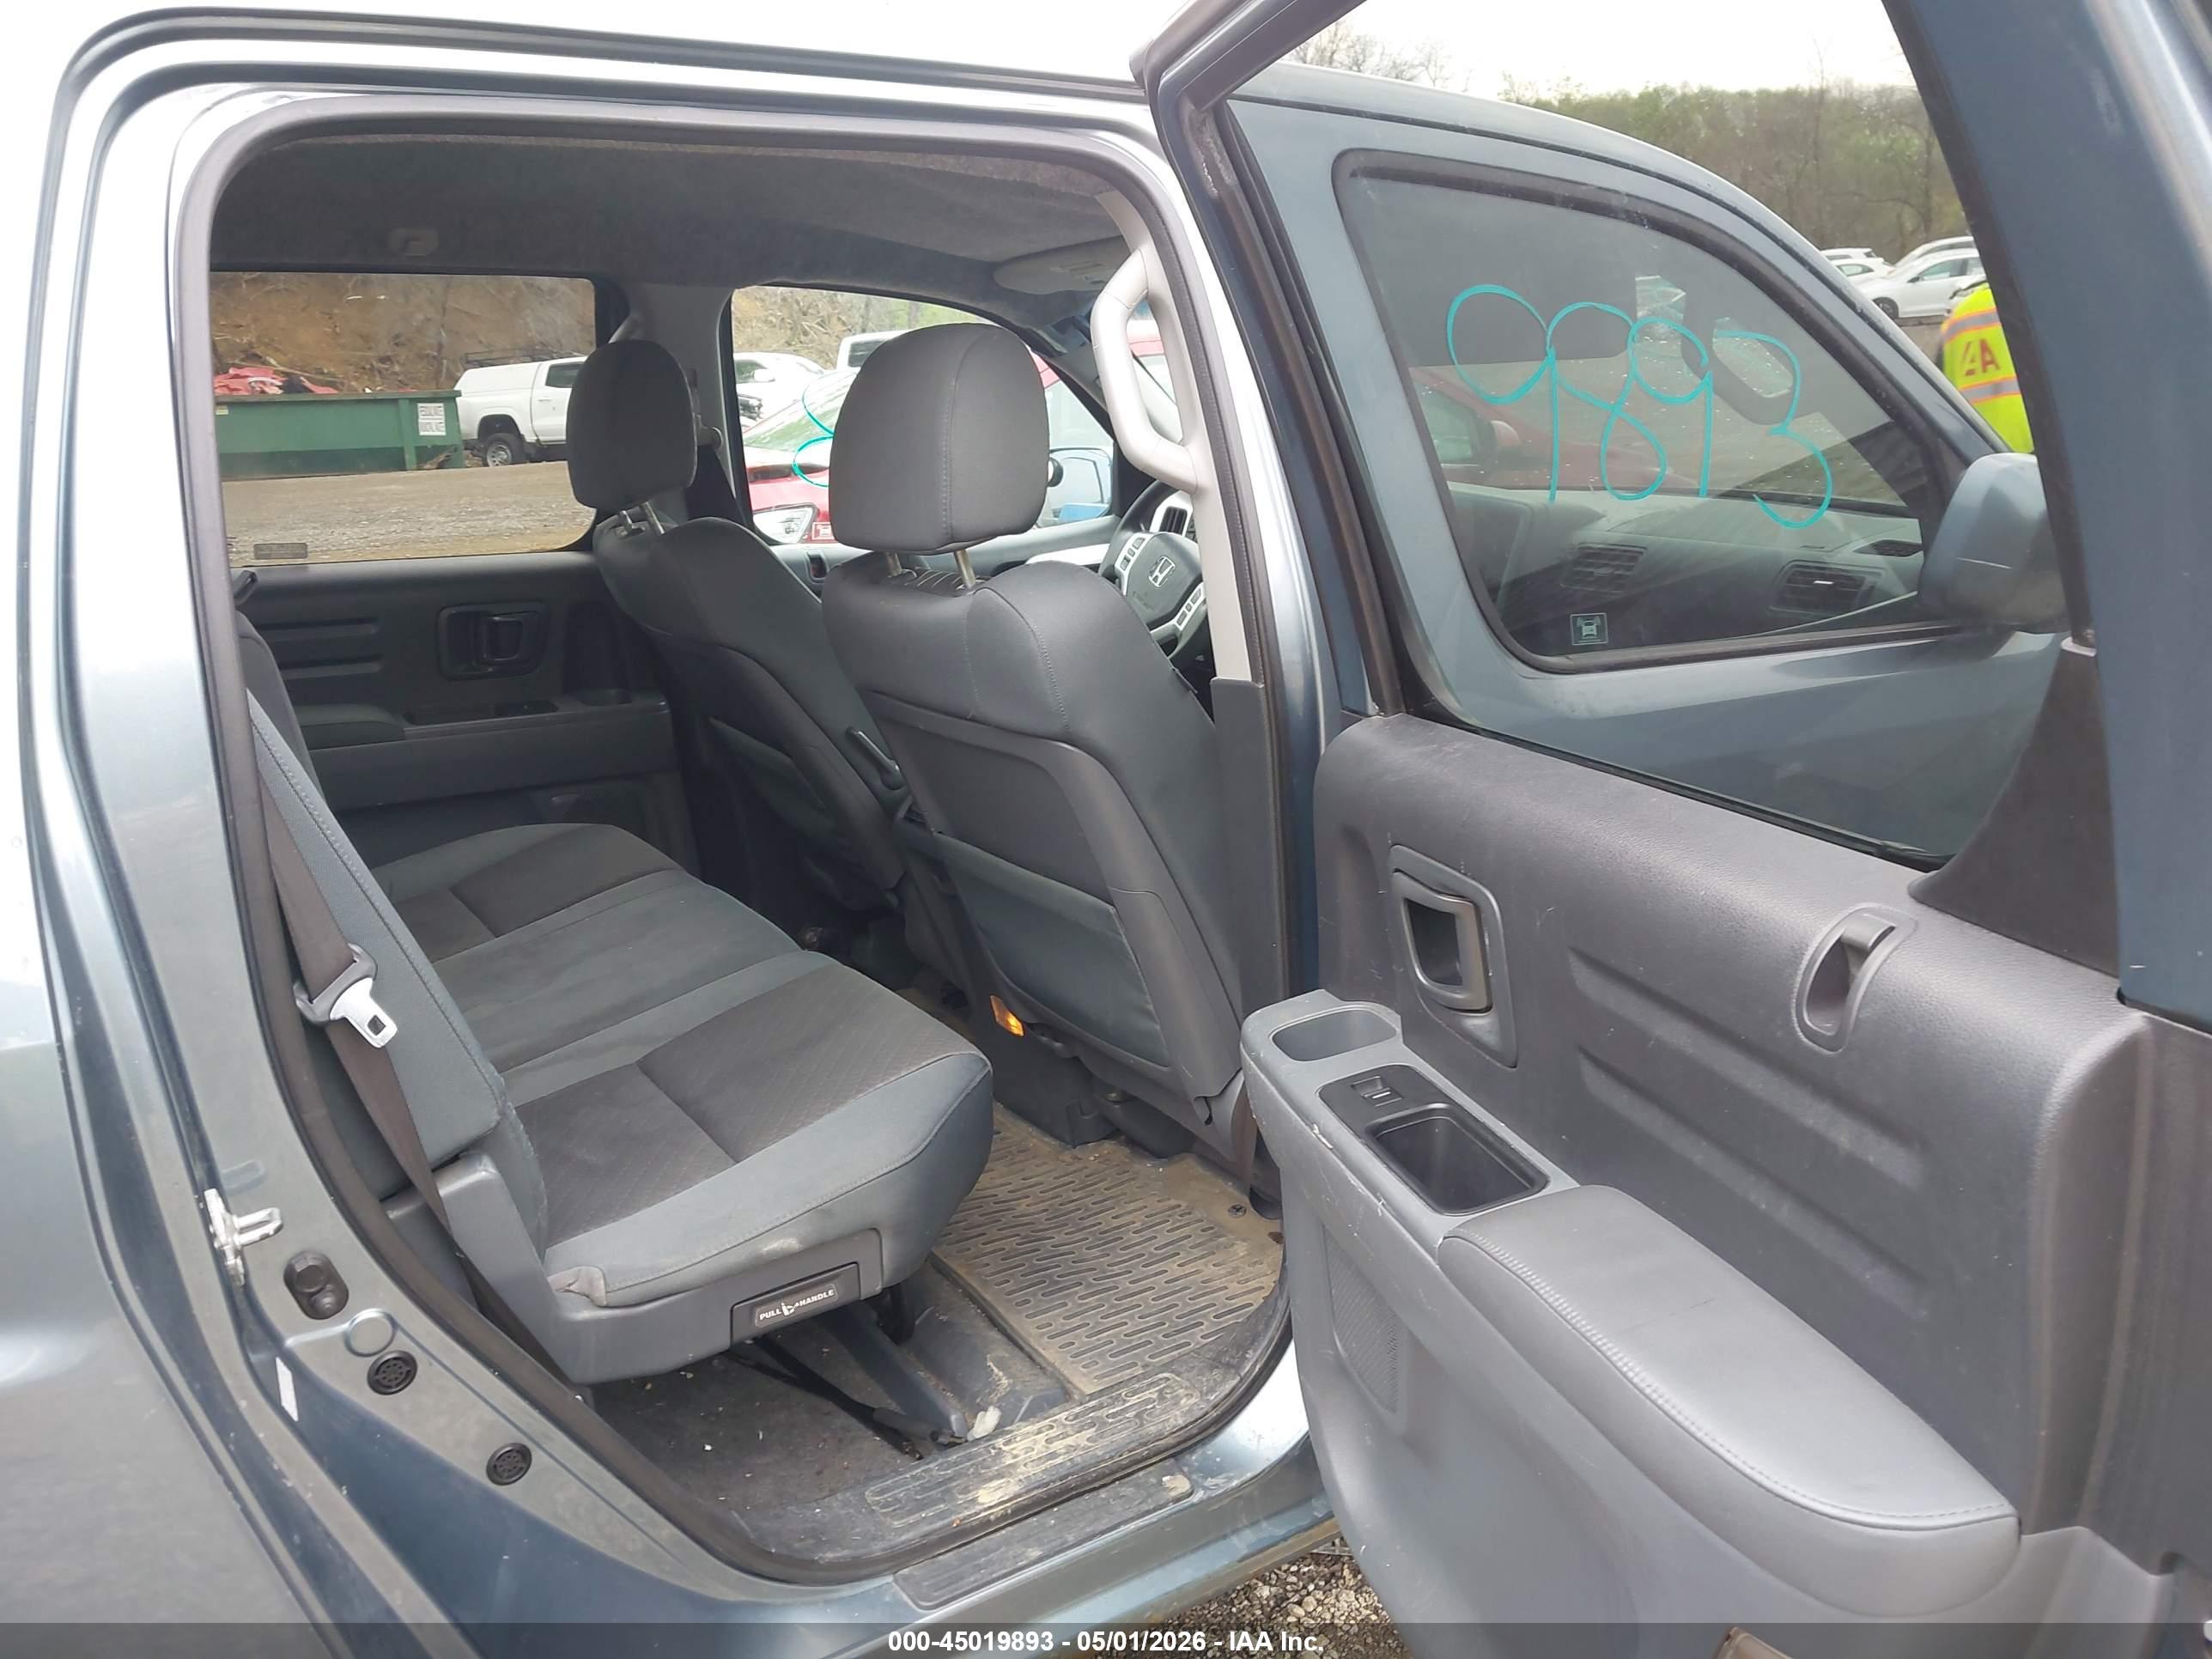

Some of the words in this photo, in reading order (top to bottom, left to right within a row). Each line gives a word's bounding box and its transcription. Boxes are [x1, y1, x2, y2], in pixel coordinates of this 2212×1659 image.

[1446, 283, 1832, 530] 9893
[759, 1308, 782, 1322] PULL
[799, 1289, 836, 1307] HANDLE
